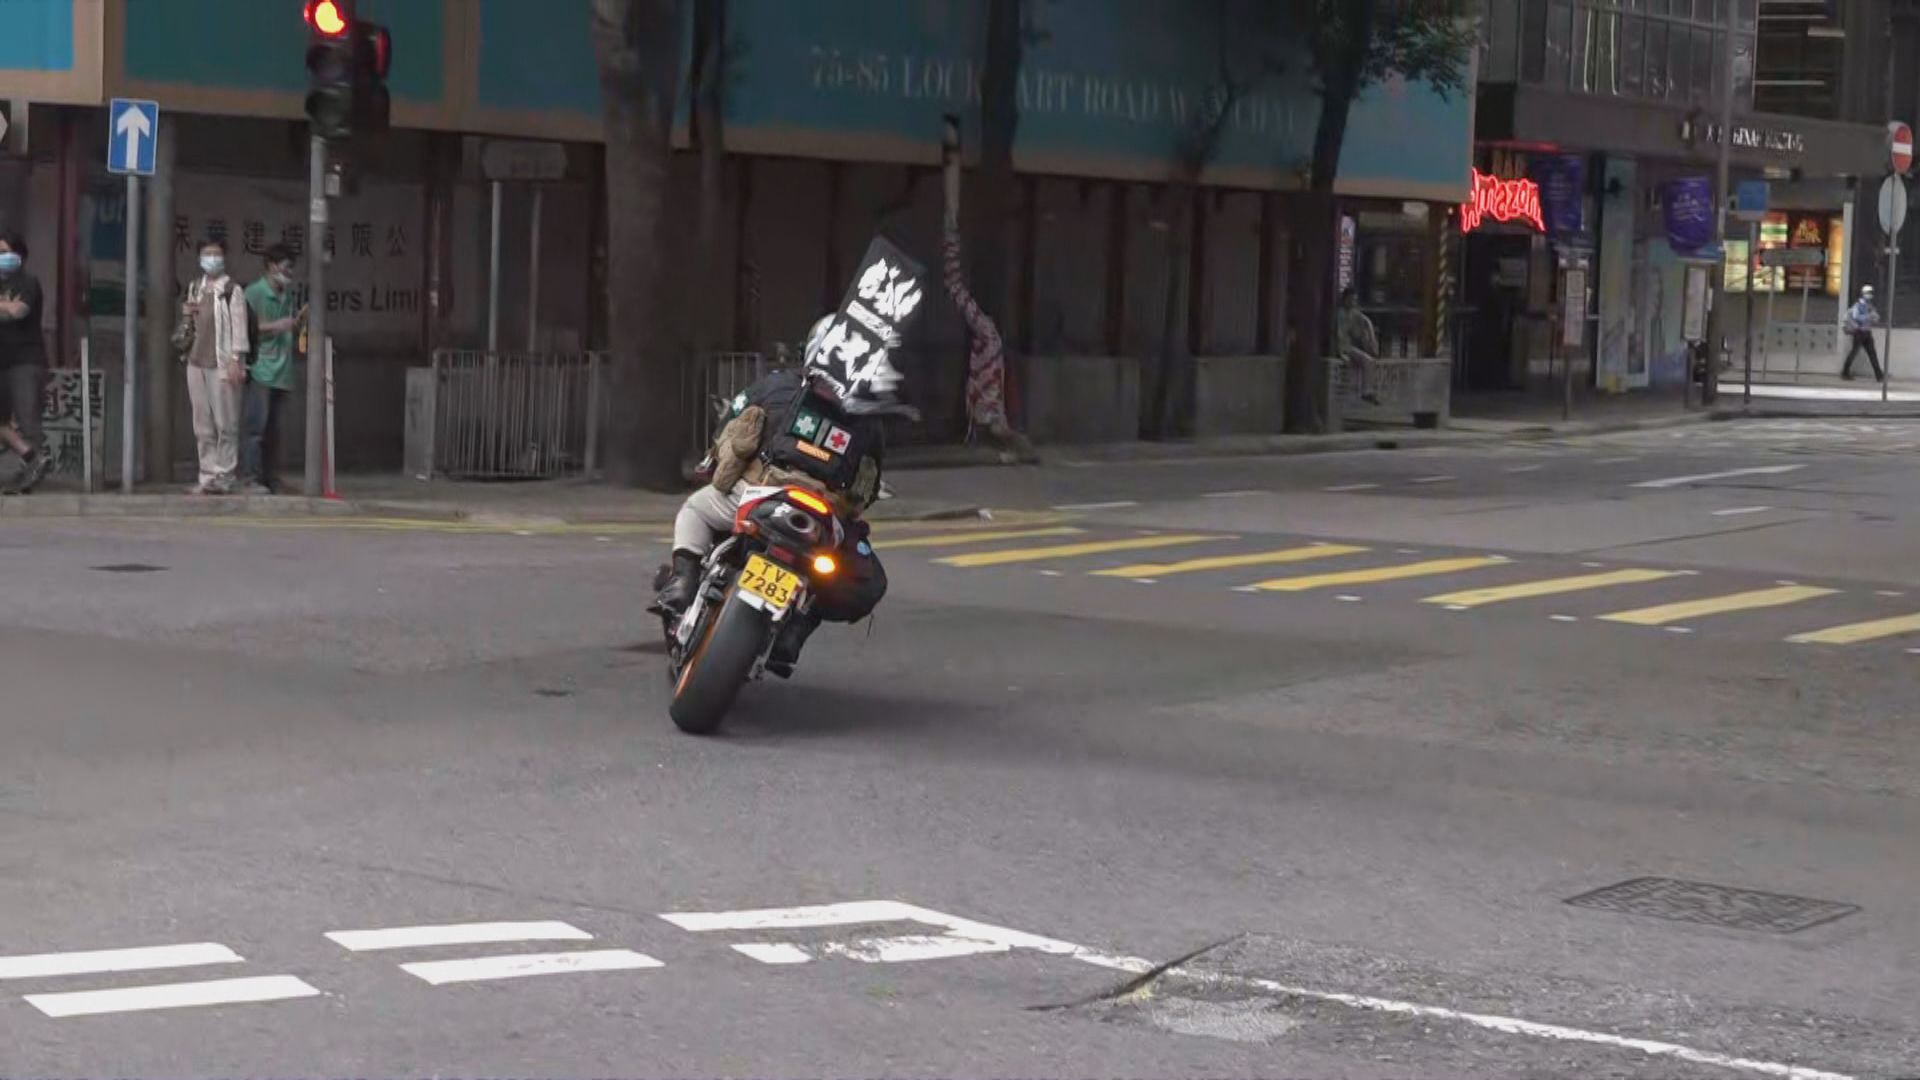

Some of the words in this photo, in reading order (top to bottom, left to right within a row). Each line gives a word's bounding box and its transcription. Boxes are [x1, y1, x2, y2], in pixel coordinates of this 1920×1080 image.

[811, 46, 888, 96] 75-85
[901, 54, 1073, 113] LOCKART
[1083, 76, 1160, 122] ROAD
[742, 569, 789, 603] 7283
[762, 561, 787, 583] TV
